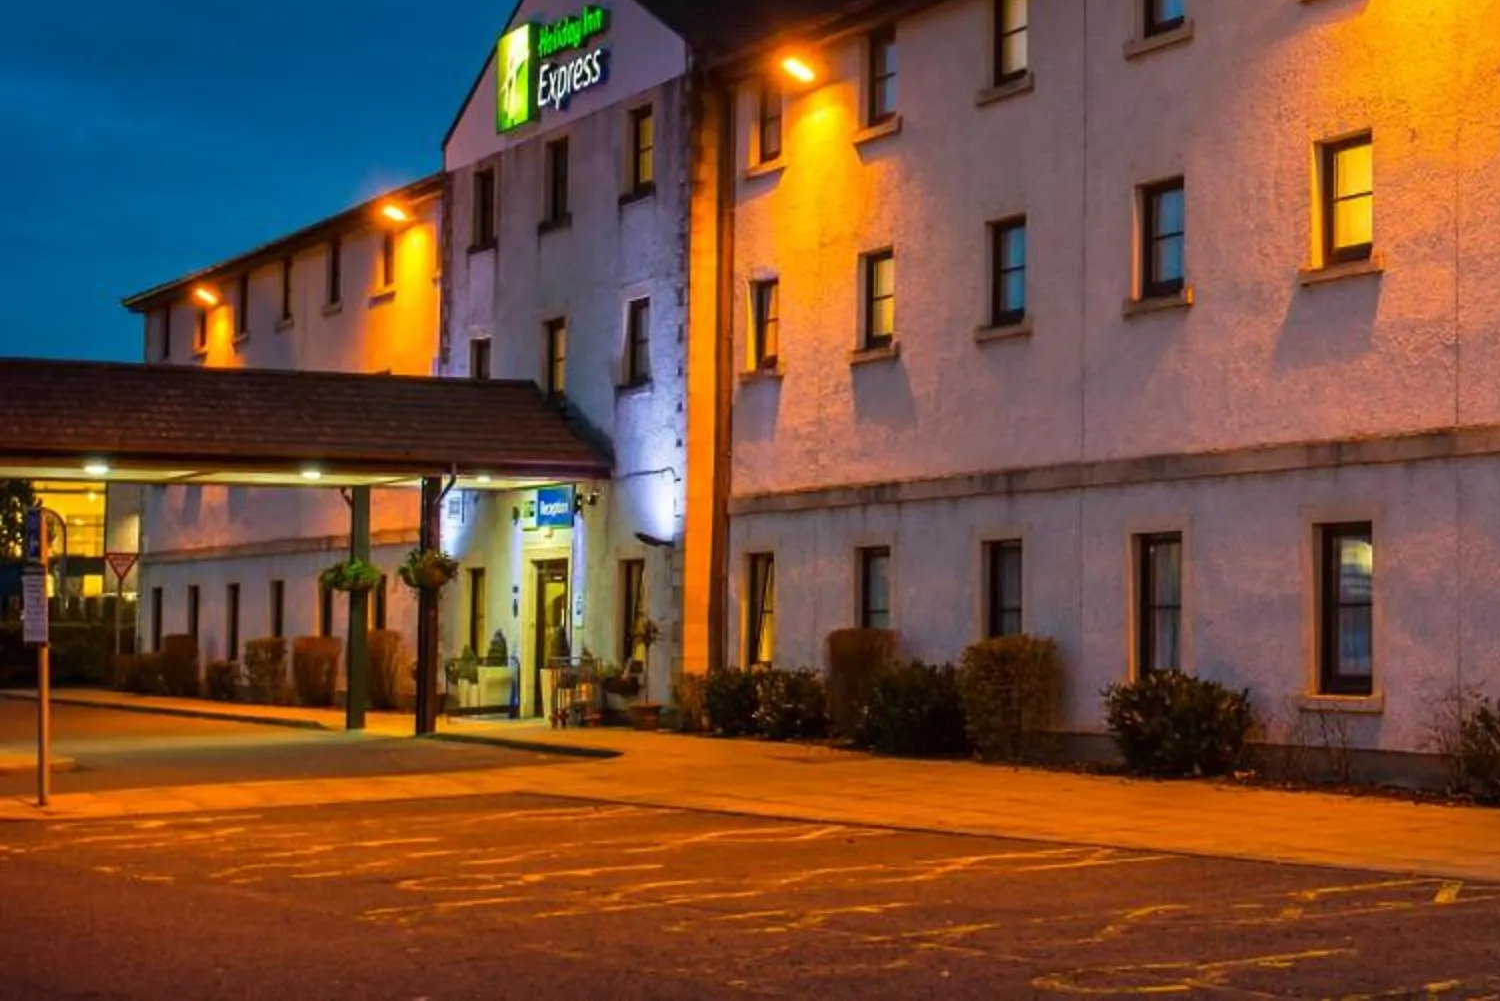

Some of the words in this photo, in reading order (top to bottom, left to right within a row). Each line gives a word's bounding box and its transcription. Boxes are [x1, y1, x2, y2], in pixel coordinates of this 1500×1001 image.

[538, 16, 580, 57] Holiday
[583, 5, 602, 35] Inn
[538, 48, 602, 110] Express
